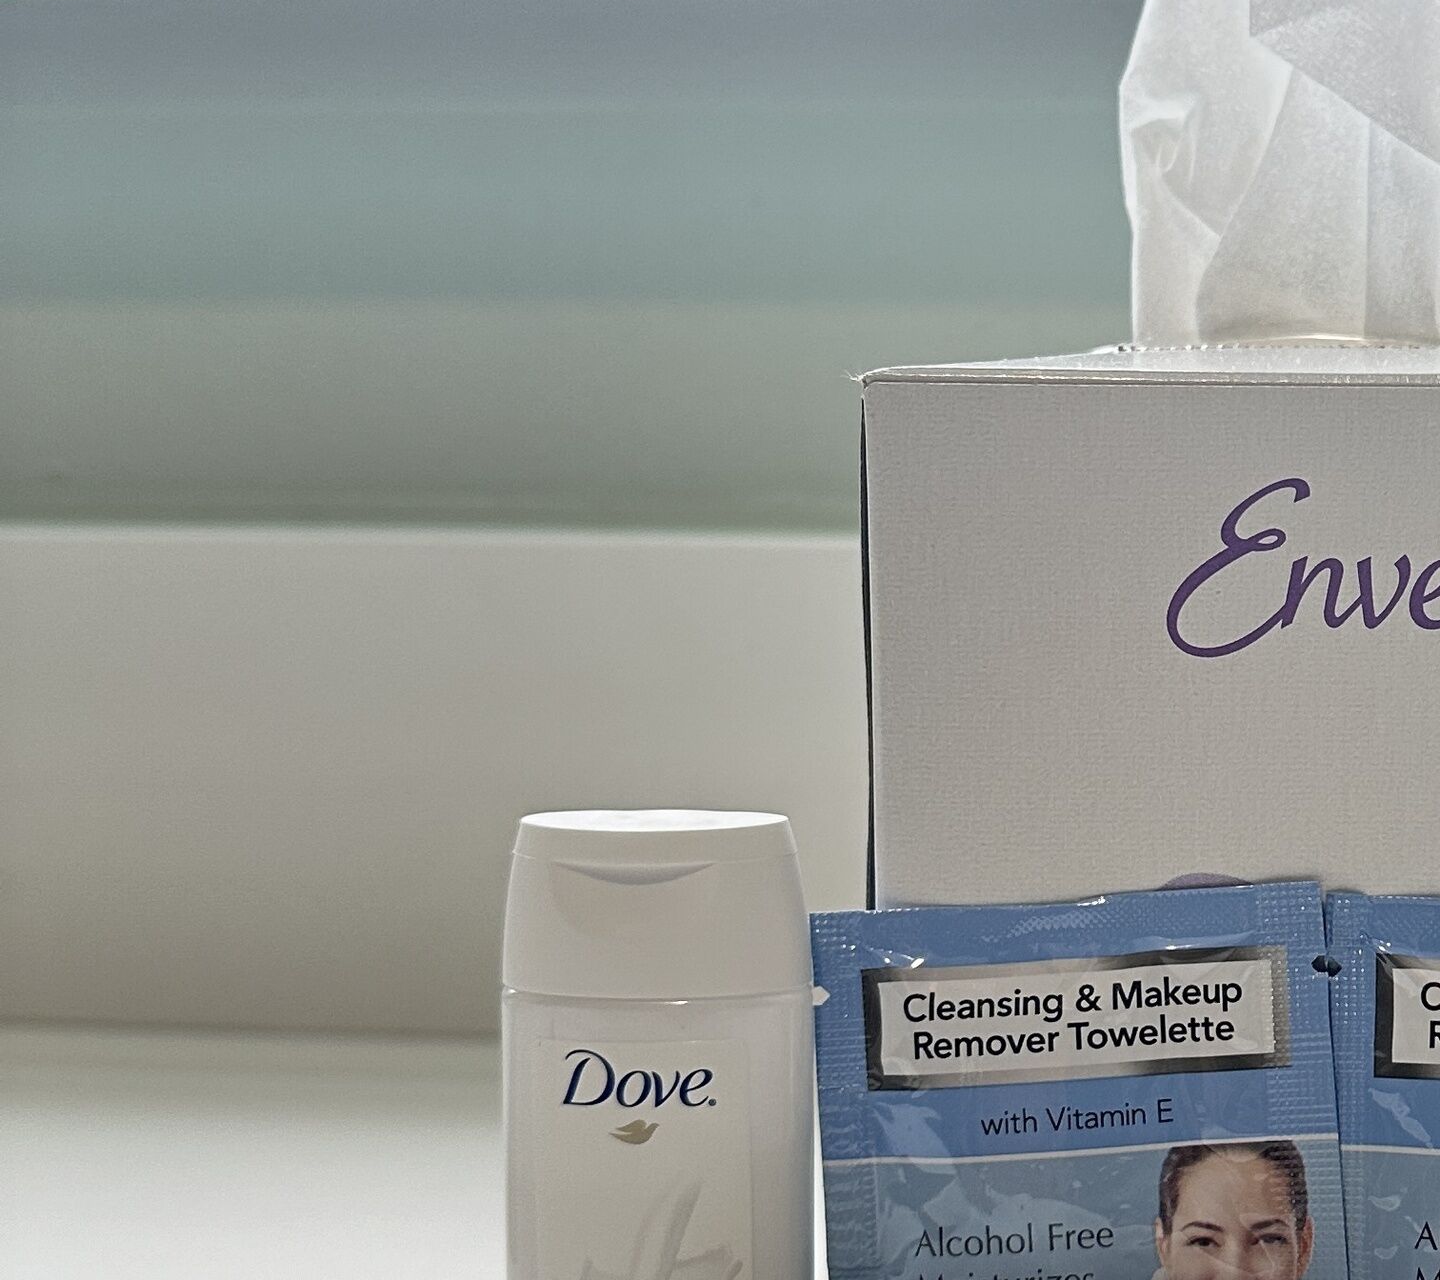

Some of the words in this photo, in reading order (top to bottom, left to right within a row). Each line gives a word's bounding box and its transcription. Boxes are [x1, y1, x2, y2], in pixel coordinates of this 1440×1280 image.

[903, 991, 1063, 1024] Cleansing
[1075, 984, 1102, 1013] &
[1111, 978, 1243, 1012] Makeup
[913, 1028, 1059, 1060] Remover
[1067, 1016, 1235, 1052] Towelette
[980, 1108, 1038, 1136] with
[1046, 1103, 1148, 1132] Vitamin
[1158, 1098, 1174, 1123] E
[915, 1223, 1034, 1257] Alcohol
[1049, 1223, 1114, 1251] Free
